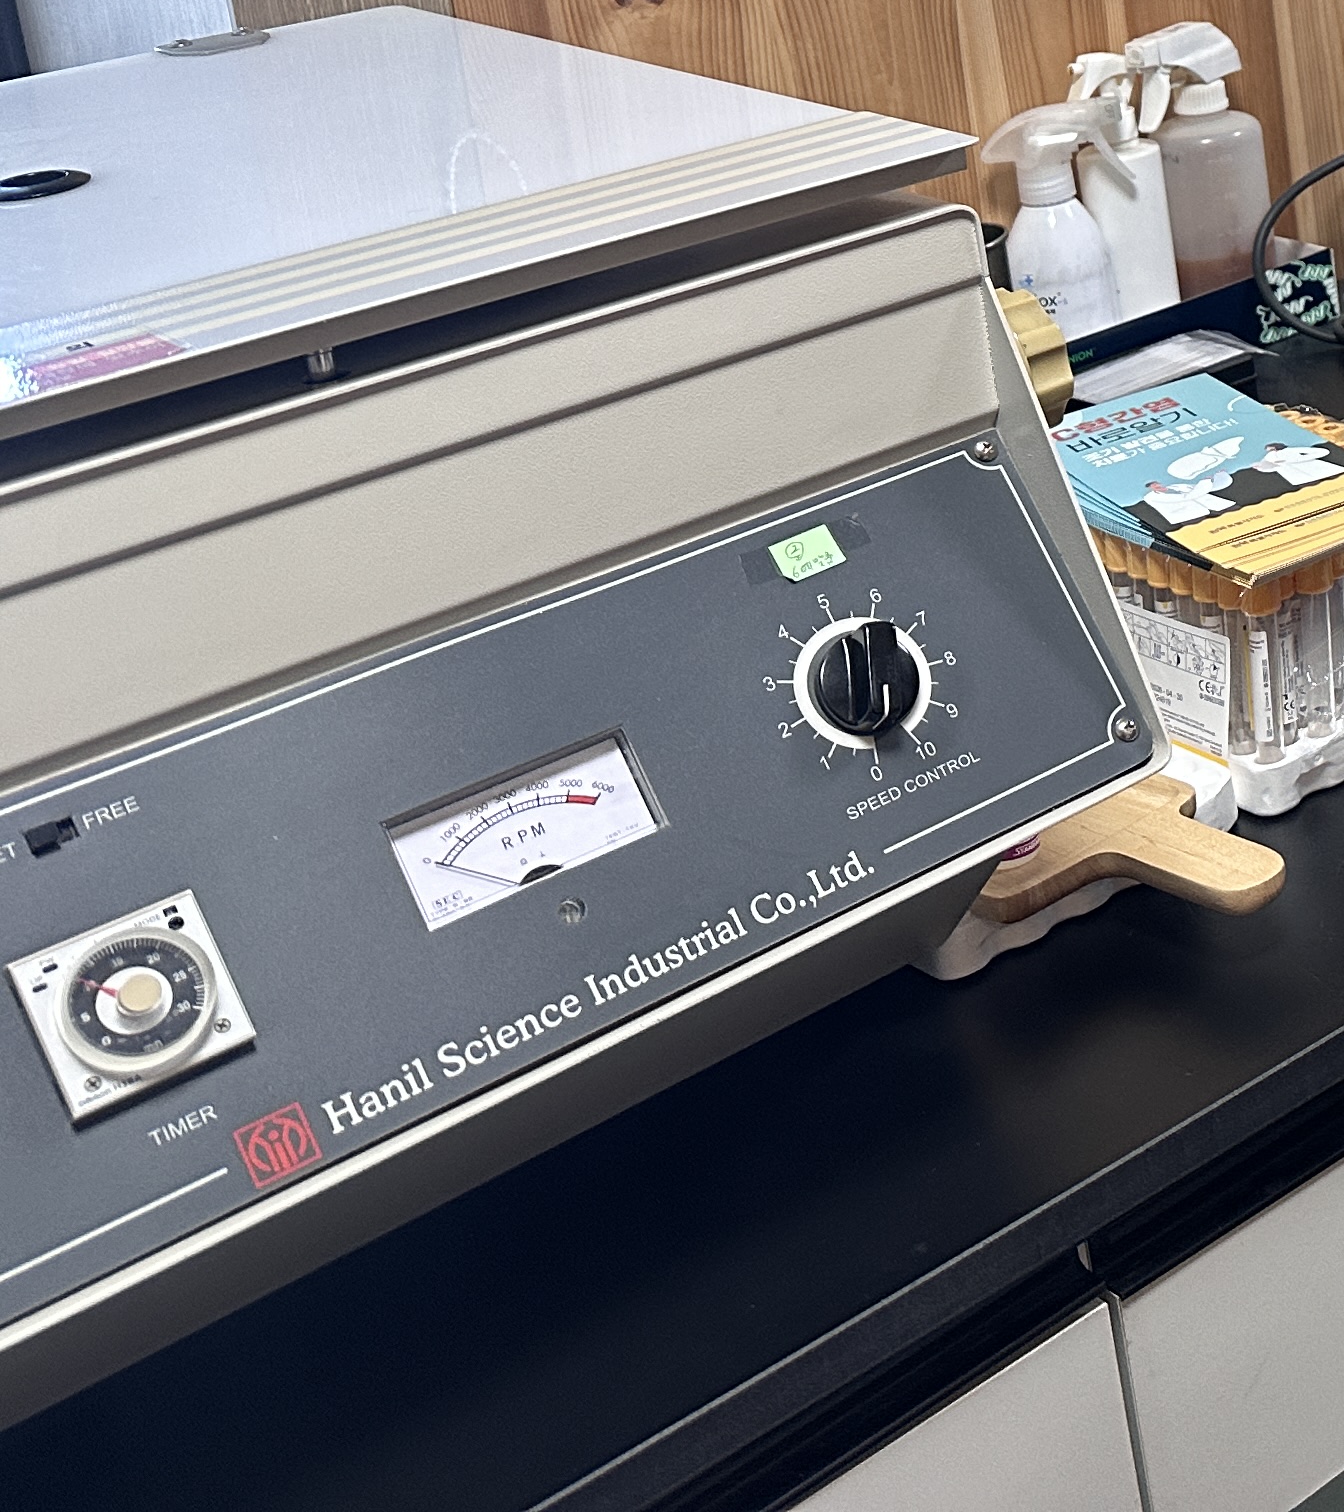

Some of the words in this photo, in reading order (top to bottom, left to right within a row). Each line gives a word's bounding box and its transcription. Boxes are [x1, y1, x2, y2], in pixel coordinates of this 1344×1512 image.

[1051, 396, 1181, 442] C형간염
[1066, 407, 1198, 453] 바로알기
[816, 594, 830, 609] 5
[869, 588, 882, 603] 6
[916, 610, 927, 626] 7
[778, 624, 790, 639] 4
[944, 651, 957, 666] 8
[762, 676, 776, 691] 3
[946, 703, 959, 718] 9
[778, 722, 792, 739] 2
[916, 741, 937, 760] 10
[820, 755, 831, 770] 1
[870, 766, 883, 781] 0
[525, 780, 549, 793] 4000
[559, 779, 583, 788] 5000
[846, 786, 902, 820] SPEED
[904, 751, 981, 793] CONTROL
[493, 789, 517, 804] 3000
[82, 796, 140, 830] FREE
[465, 803, 489, 821] 2000
[439, 823, 461, 843] 1000
[147, 952, 161, 964] 20
[172, 969, 187, 982] 25
[321, 1059, 436, 1136] Hanil
[437, 995, 584, 1081] Science
[585, 908, 747, 1007] Industrial
[749, 850, 877, 926] Co.,Ltd.
[176, 1000, 191, 1013] 30
[80, 1011, 91, 1023] 5
[101, 1035, 112, 1047] 0
[148, 1104, 219, 1147] TIMER
